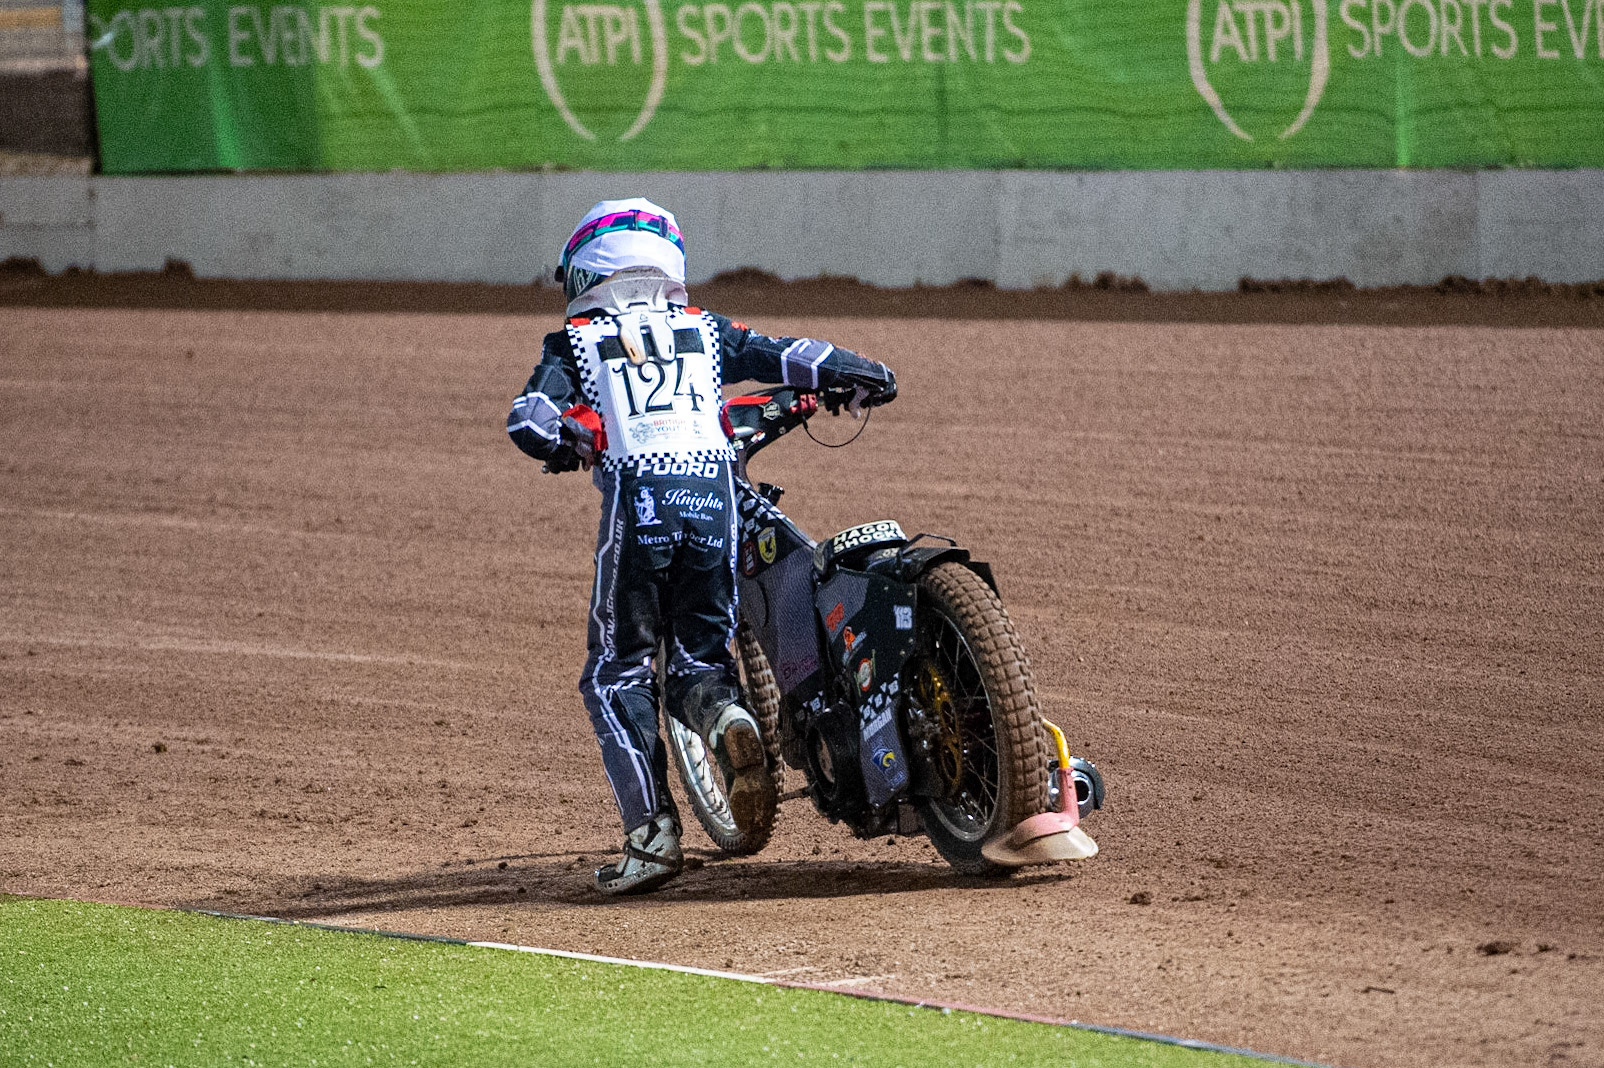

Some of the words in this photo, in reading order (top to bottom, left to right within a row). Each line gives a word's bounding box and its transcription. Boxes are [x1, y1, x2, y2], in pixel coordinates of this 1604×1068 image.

[227, 5, 385, 68] EVENTS
[556, 5, 642, 65] ATPI
[676, 2, 852, 65] SPORTS
[864, 1, 1032, 64] EVENTS
[1210, 0, 1303, 63] ATPI
[1339, 0, 1519, 59] SPORTS
[612, 357, 705, 418] 124
[661, 488, 724, 512] Knights
[637, 533, 670, 545] Metro
[672, 530, 706, 545] Tiber
[707, 535, 724, 549] Ltd
[834, 522, 900, 546] HAGON
